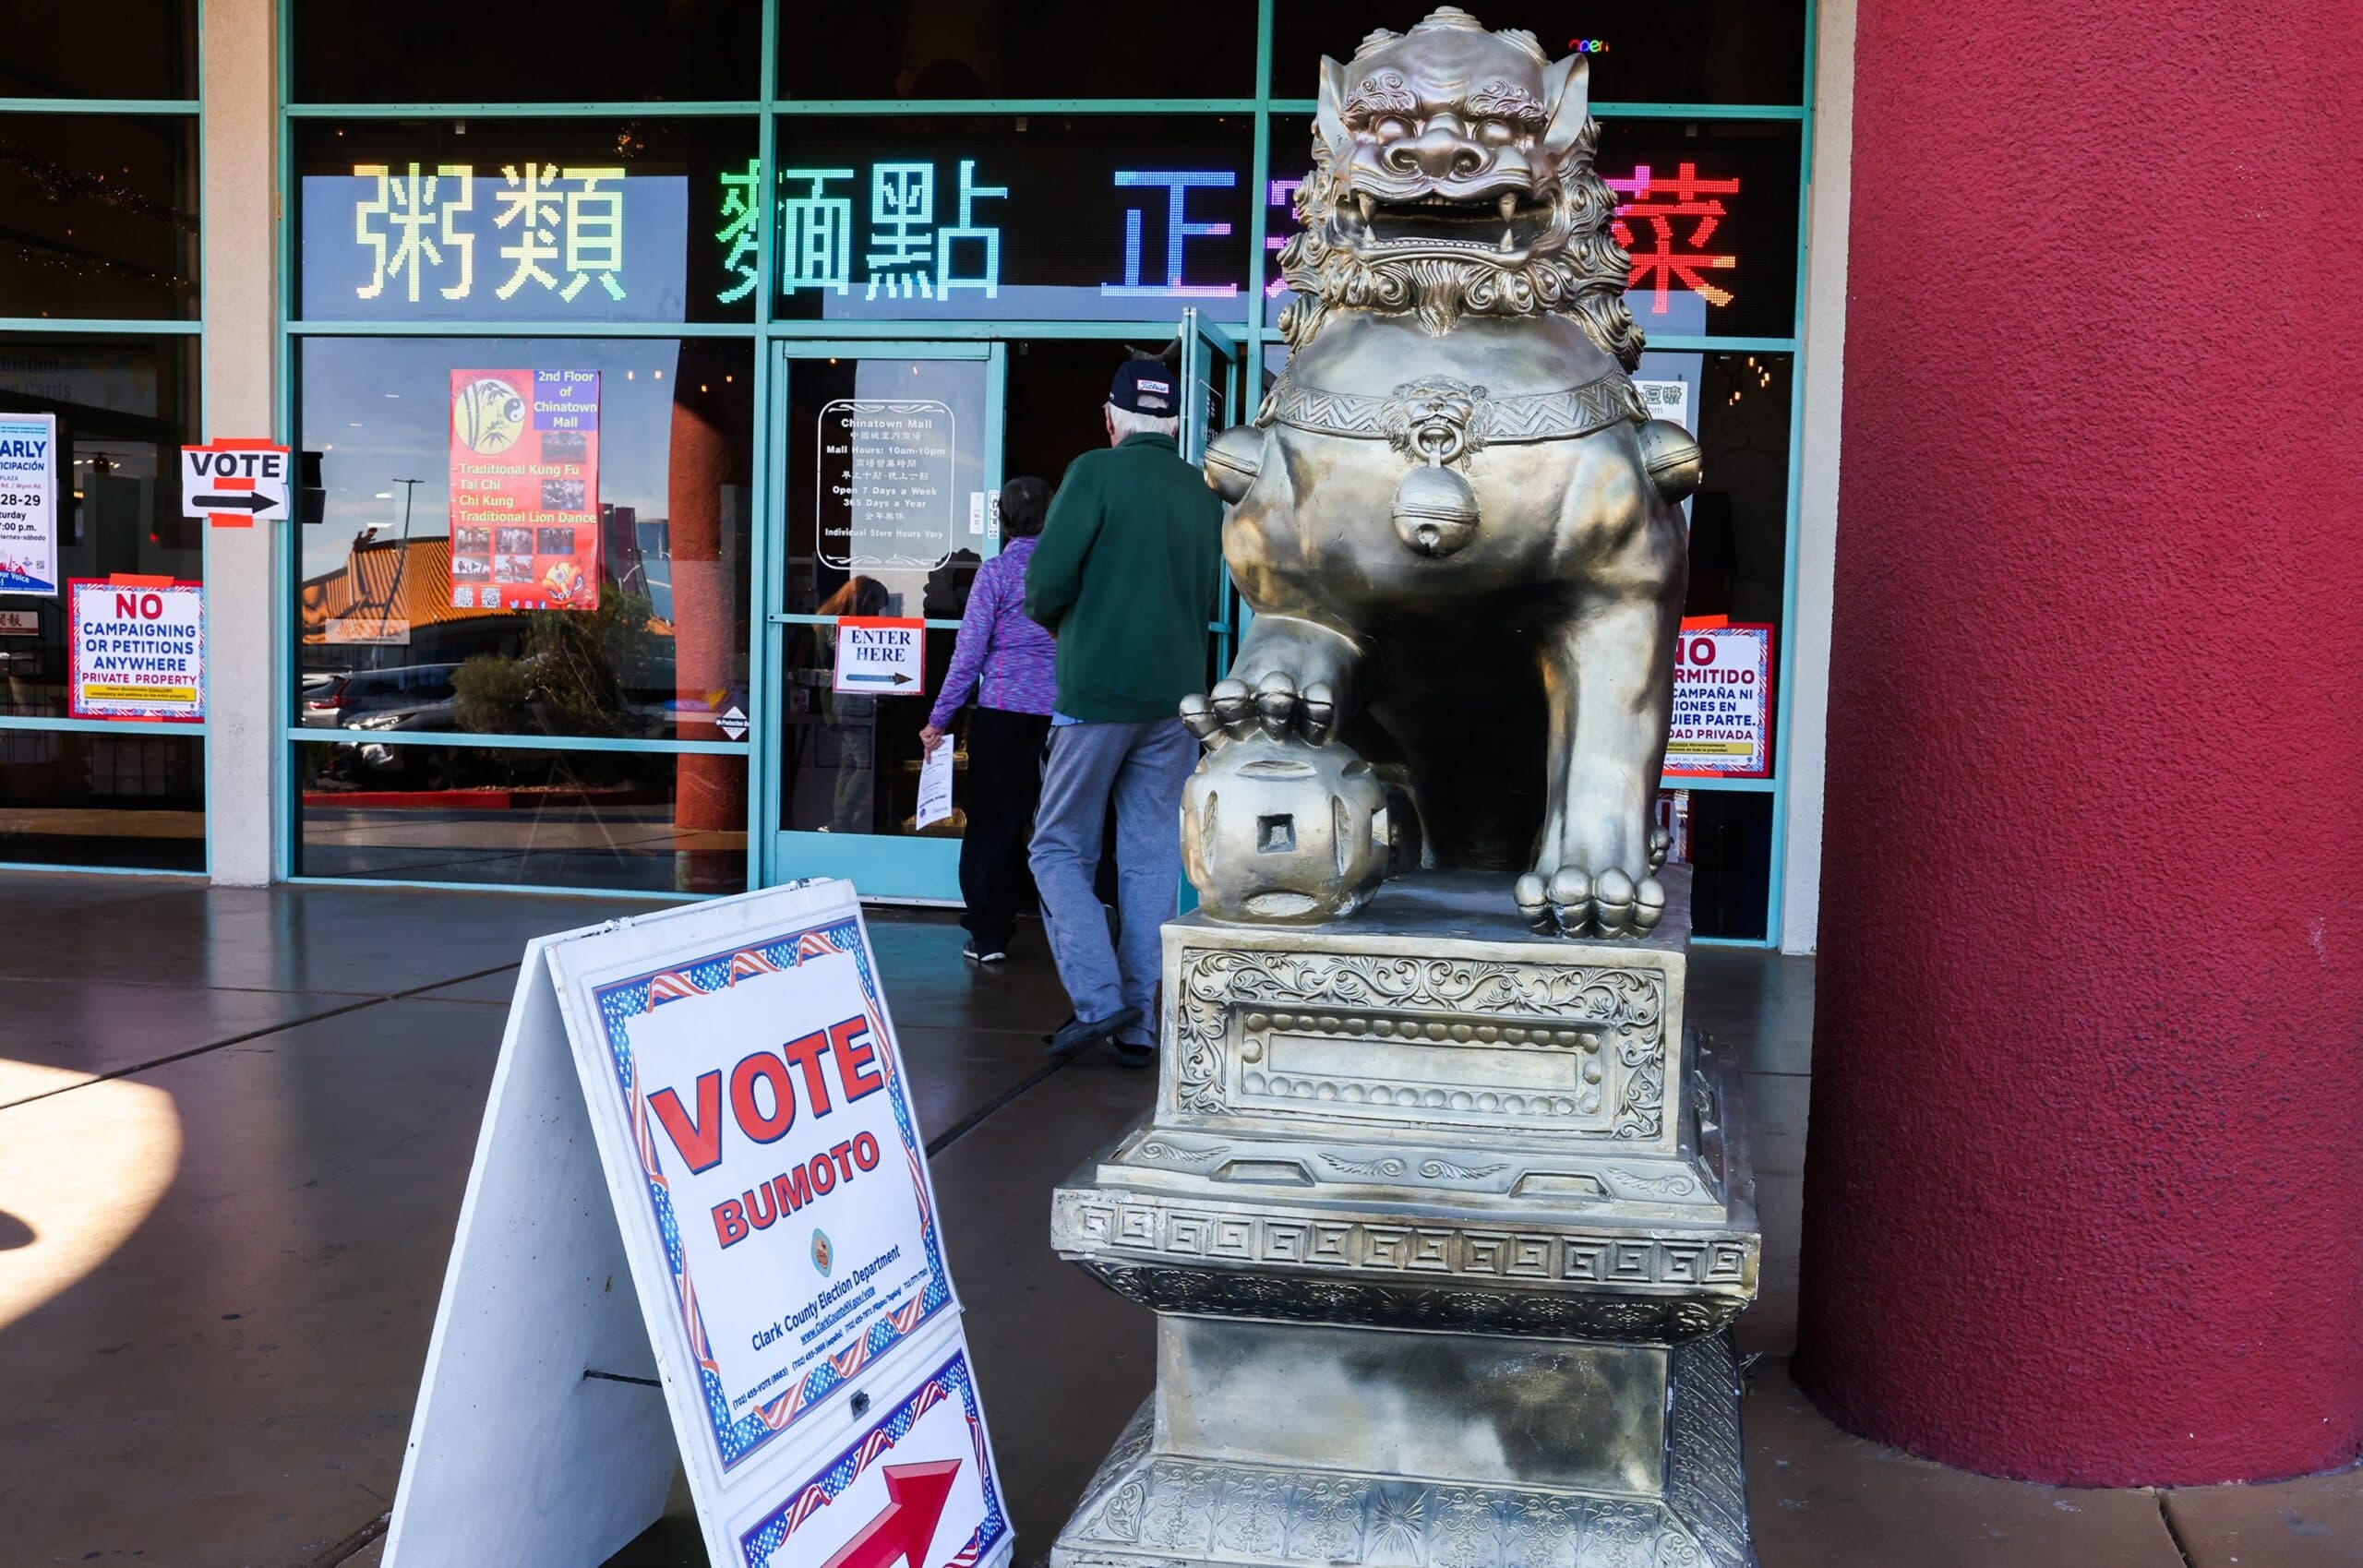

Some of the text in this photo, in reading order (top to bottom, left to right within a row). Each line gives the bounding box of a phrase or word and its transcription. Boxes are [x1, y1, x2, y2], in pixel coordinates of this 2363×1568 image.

[354, 162, 627, 302] 粥類
[715, 159, 1008, 302] 麵點
[538, 371, 594, 382] 2nd Floor
[559, 386, 573, 397] of
[534, 401, 597, 413] Chinatown
[553, 416, 578, 427] Mall
[841, 418, 932, 428] Chinatown Mall
[826, 445, 945, 456] Mall Hours: 10am-10pm
[189, 452, 281, 478] VOTE
[460, 463, 580, 477] Traditional Kung Fu
[460, 479, 500, 490] Tai Chi
[833, 485, 858, 495] Open
[863, 486, 869, 495] 7
[872, 487, 896, 497] Days
[911, 487, 937, 496] Week
[1, 494, 41, 507] 28-29
[460, 495, 514, 509] Chi Kung
[843, 498, 861, 507] 365
[866, 498, 889, 508] Days
[905, 499, 927, 508] Year
[460, 510, 597, 524] Traditional Lion Dance
[0, 522, 16, 531] :00
[825, 528, 942, 540] Individual Store Hours Vary
[116, 592, 163, 620] NO
[83, 622, 196, 638] CAMPAIGNING
[851, 629, 911, 645] ENTER
[86, 639, 194, 654] OR PETITIONS
[856, 647, 906, 663] HERE
[93, 655, 186, 672] ANYWHERE
[82, 672, 198, 685] PRIVATE PROPERTY
[1739, 689, 1753, 700] NI
[1720, 702, 1736, 712] EN
[1706, 714, 1756, 726] PARTE.
[1697, 729, 1753, 740] PRIVADA
[646, 1013, 883, 1176] VOTE
[711, 1131, 880, 1250] BUMOTO
[752, 1322, 784, 1351] Clark
[785, 1299, 818, 1333] County
[818, 1276, 854, 1310] Election
[852, 1244, 901, 1287] Department
[732, 1394, 747, 1410] (702)
[792, 1355, 806, 1371] (702)
